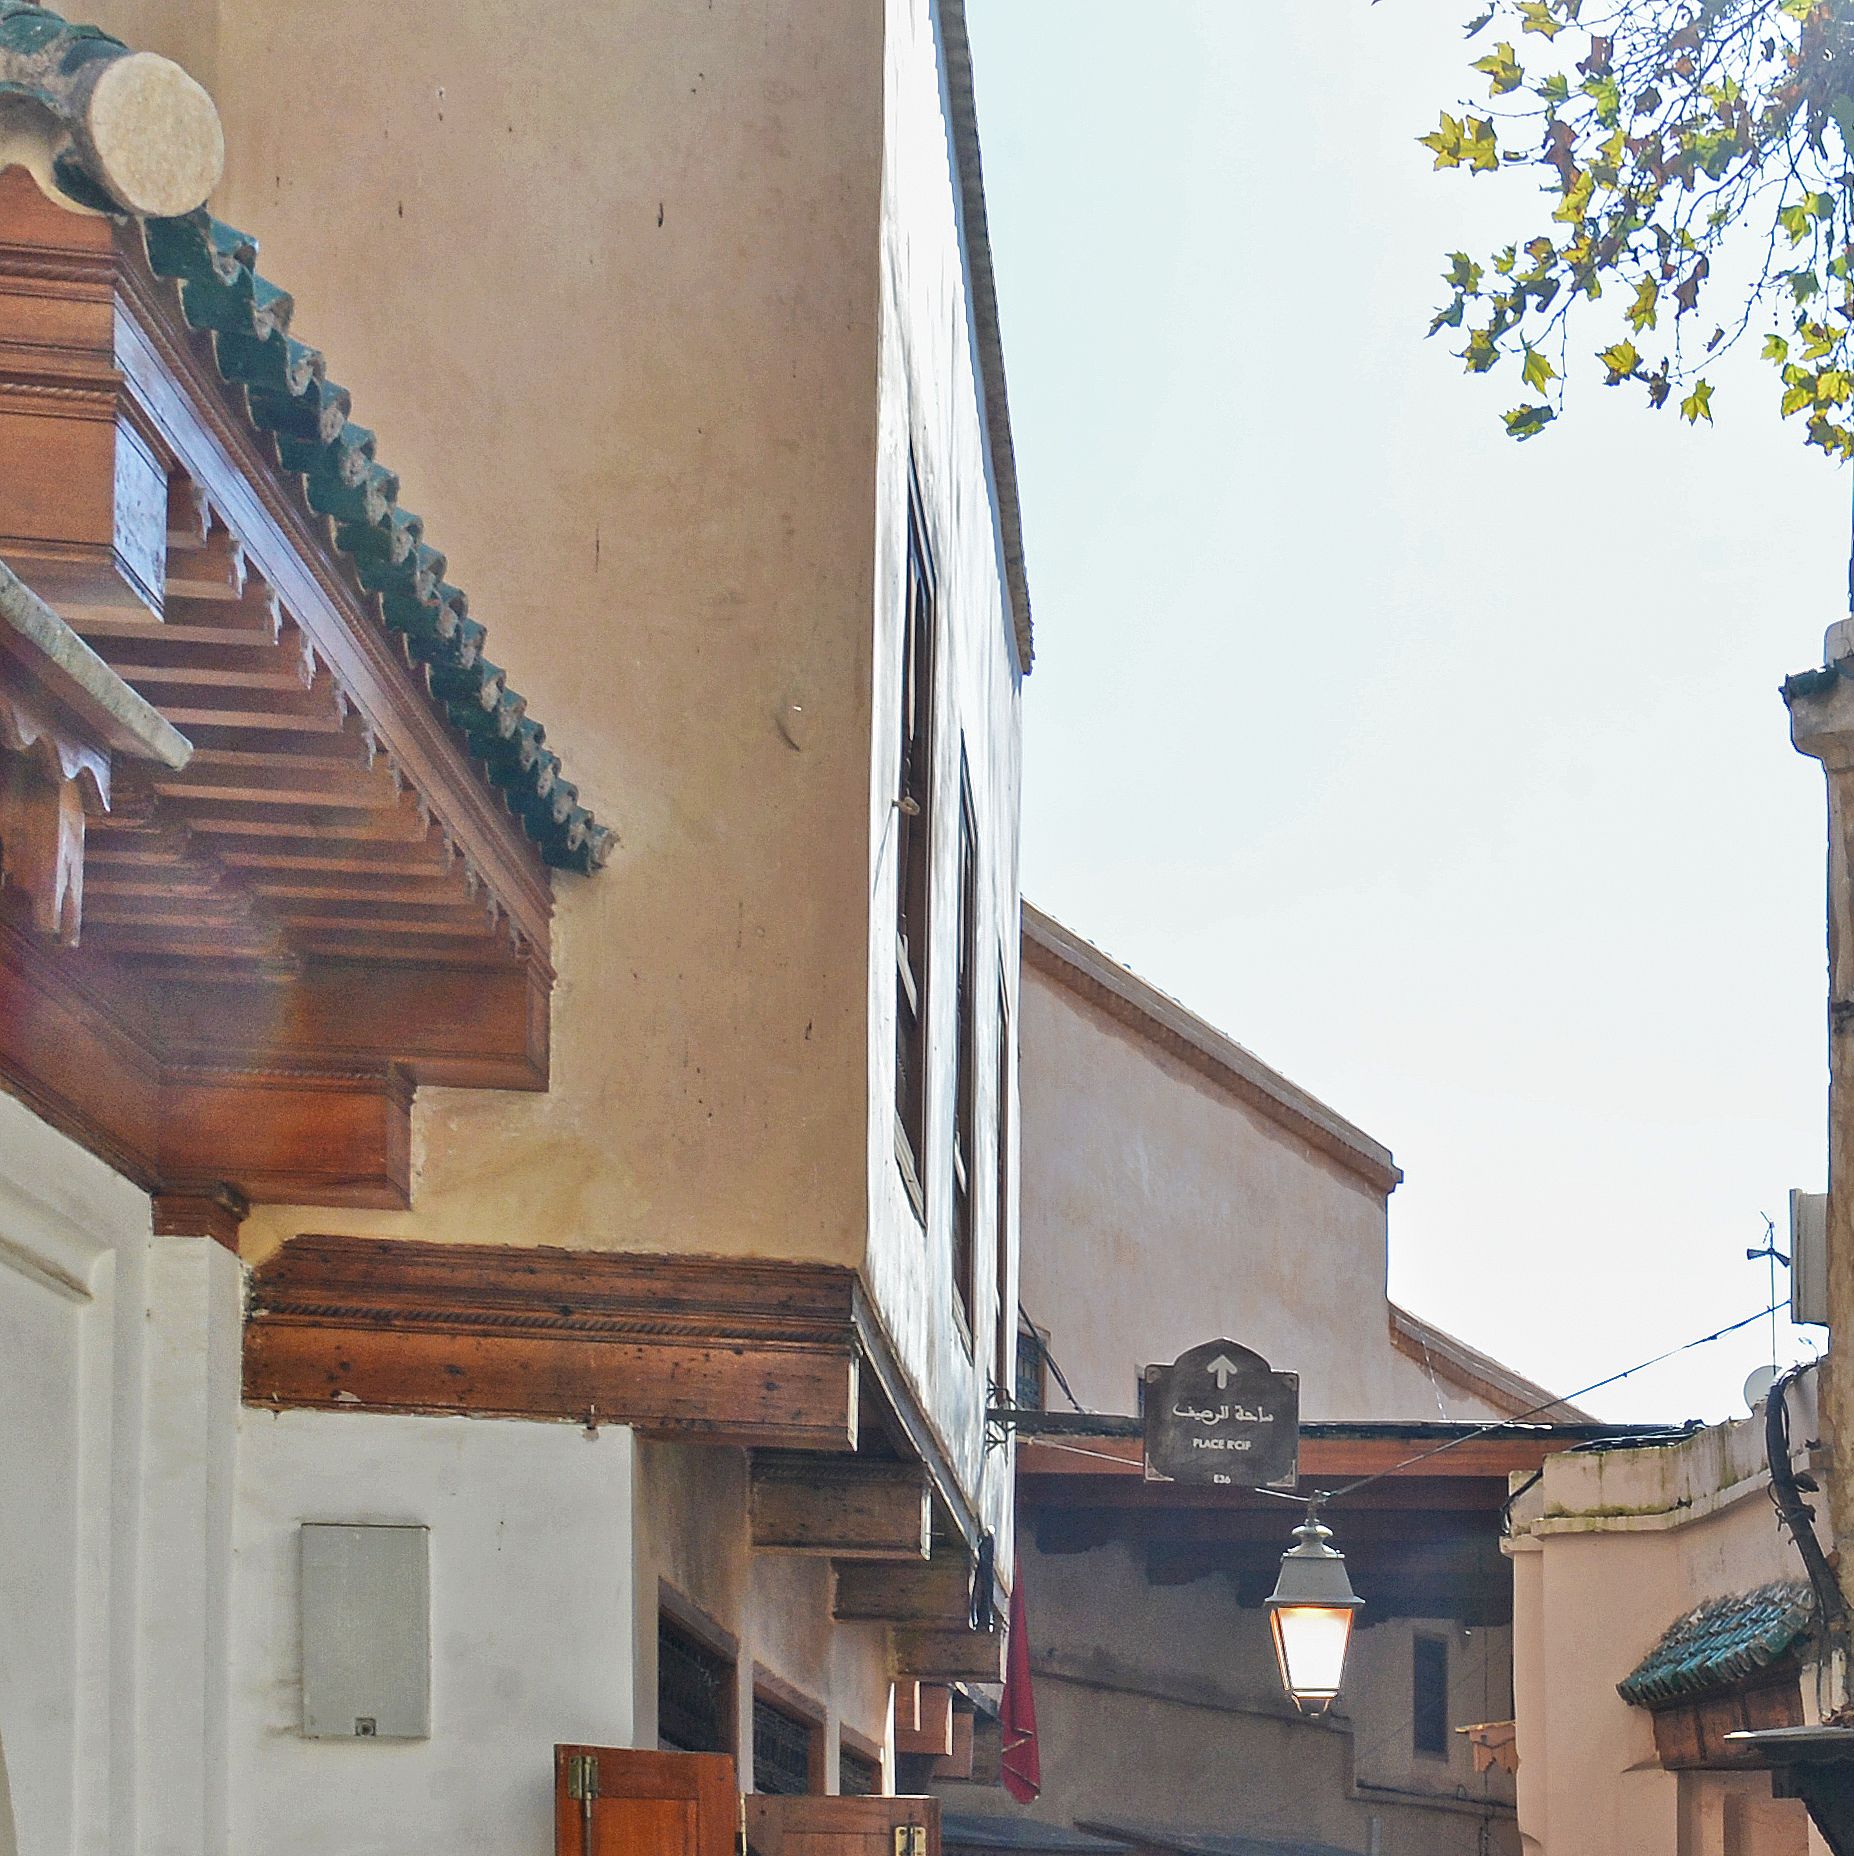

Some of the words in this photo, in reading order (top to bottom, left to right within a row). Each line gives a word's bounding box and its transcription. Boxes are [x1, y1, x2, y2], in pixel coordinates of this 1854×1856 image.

[1173, 1403, 1228, 1425] الرصيف
[1235, 1405, 1274, 1422] ساحة
[1193, 1438, 1224, 1449] PLACE
